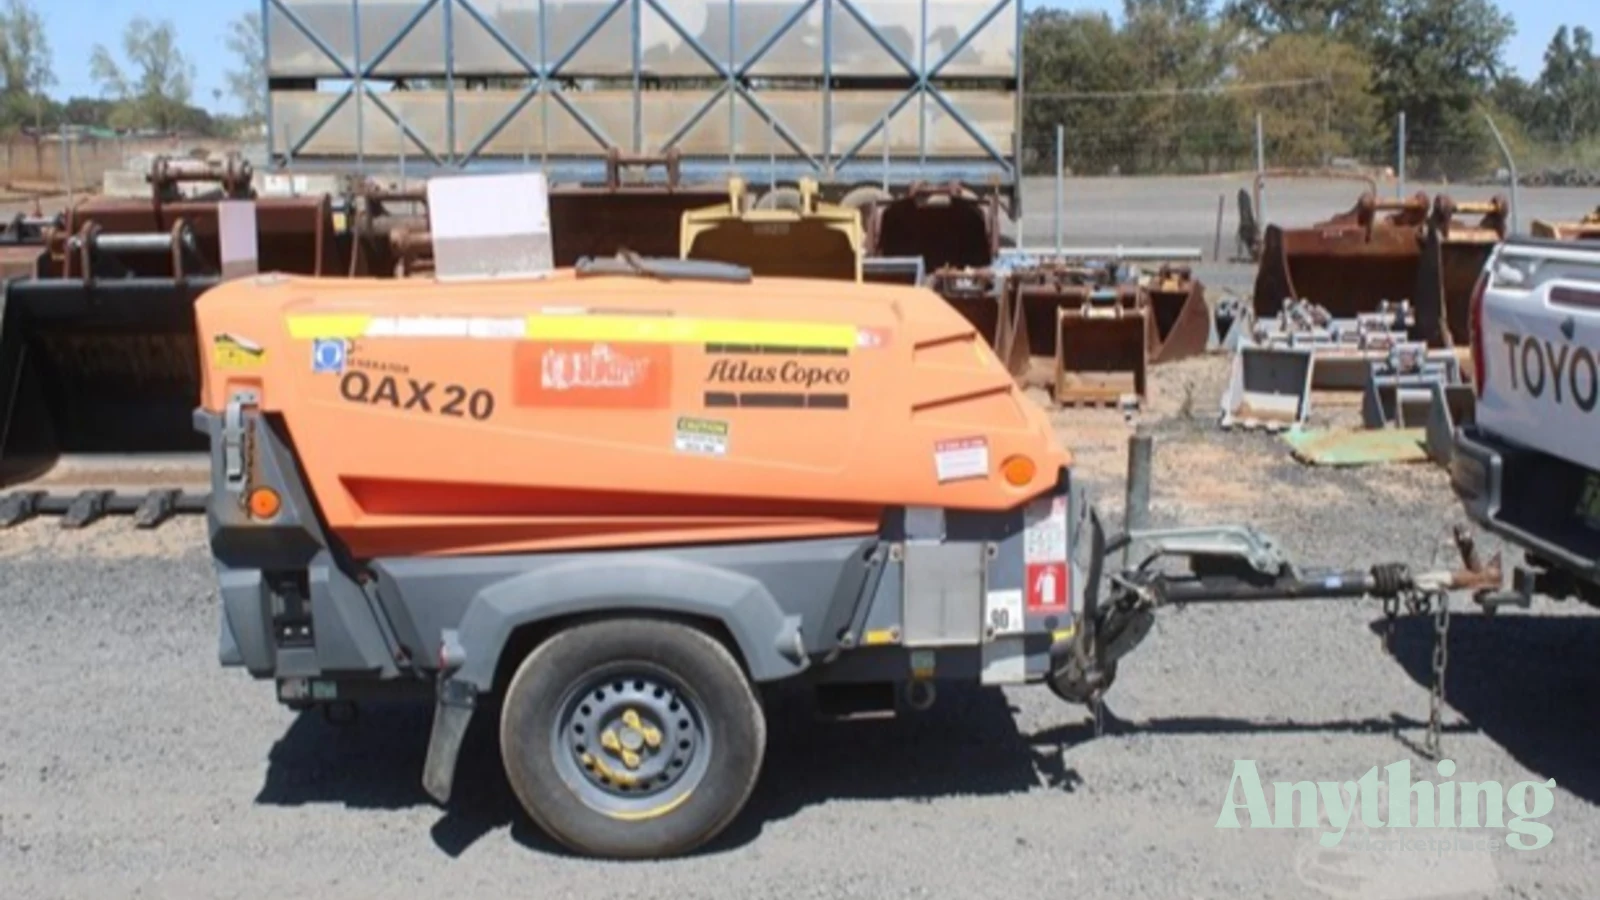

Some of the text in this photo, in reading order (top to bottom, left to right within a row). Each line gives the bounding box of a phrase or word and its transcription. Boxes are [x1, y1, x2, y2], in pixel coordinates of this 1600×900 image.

[346, 357, 411, 375] ENERATOR
[705, 358, 851, 388] Atlas Copco
[1503, 331, 1600, 414] TOYO
[339, 370, 495, 421] QAX 20
